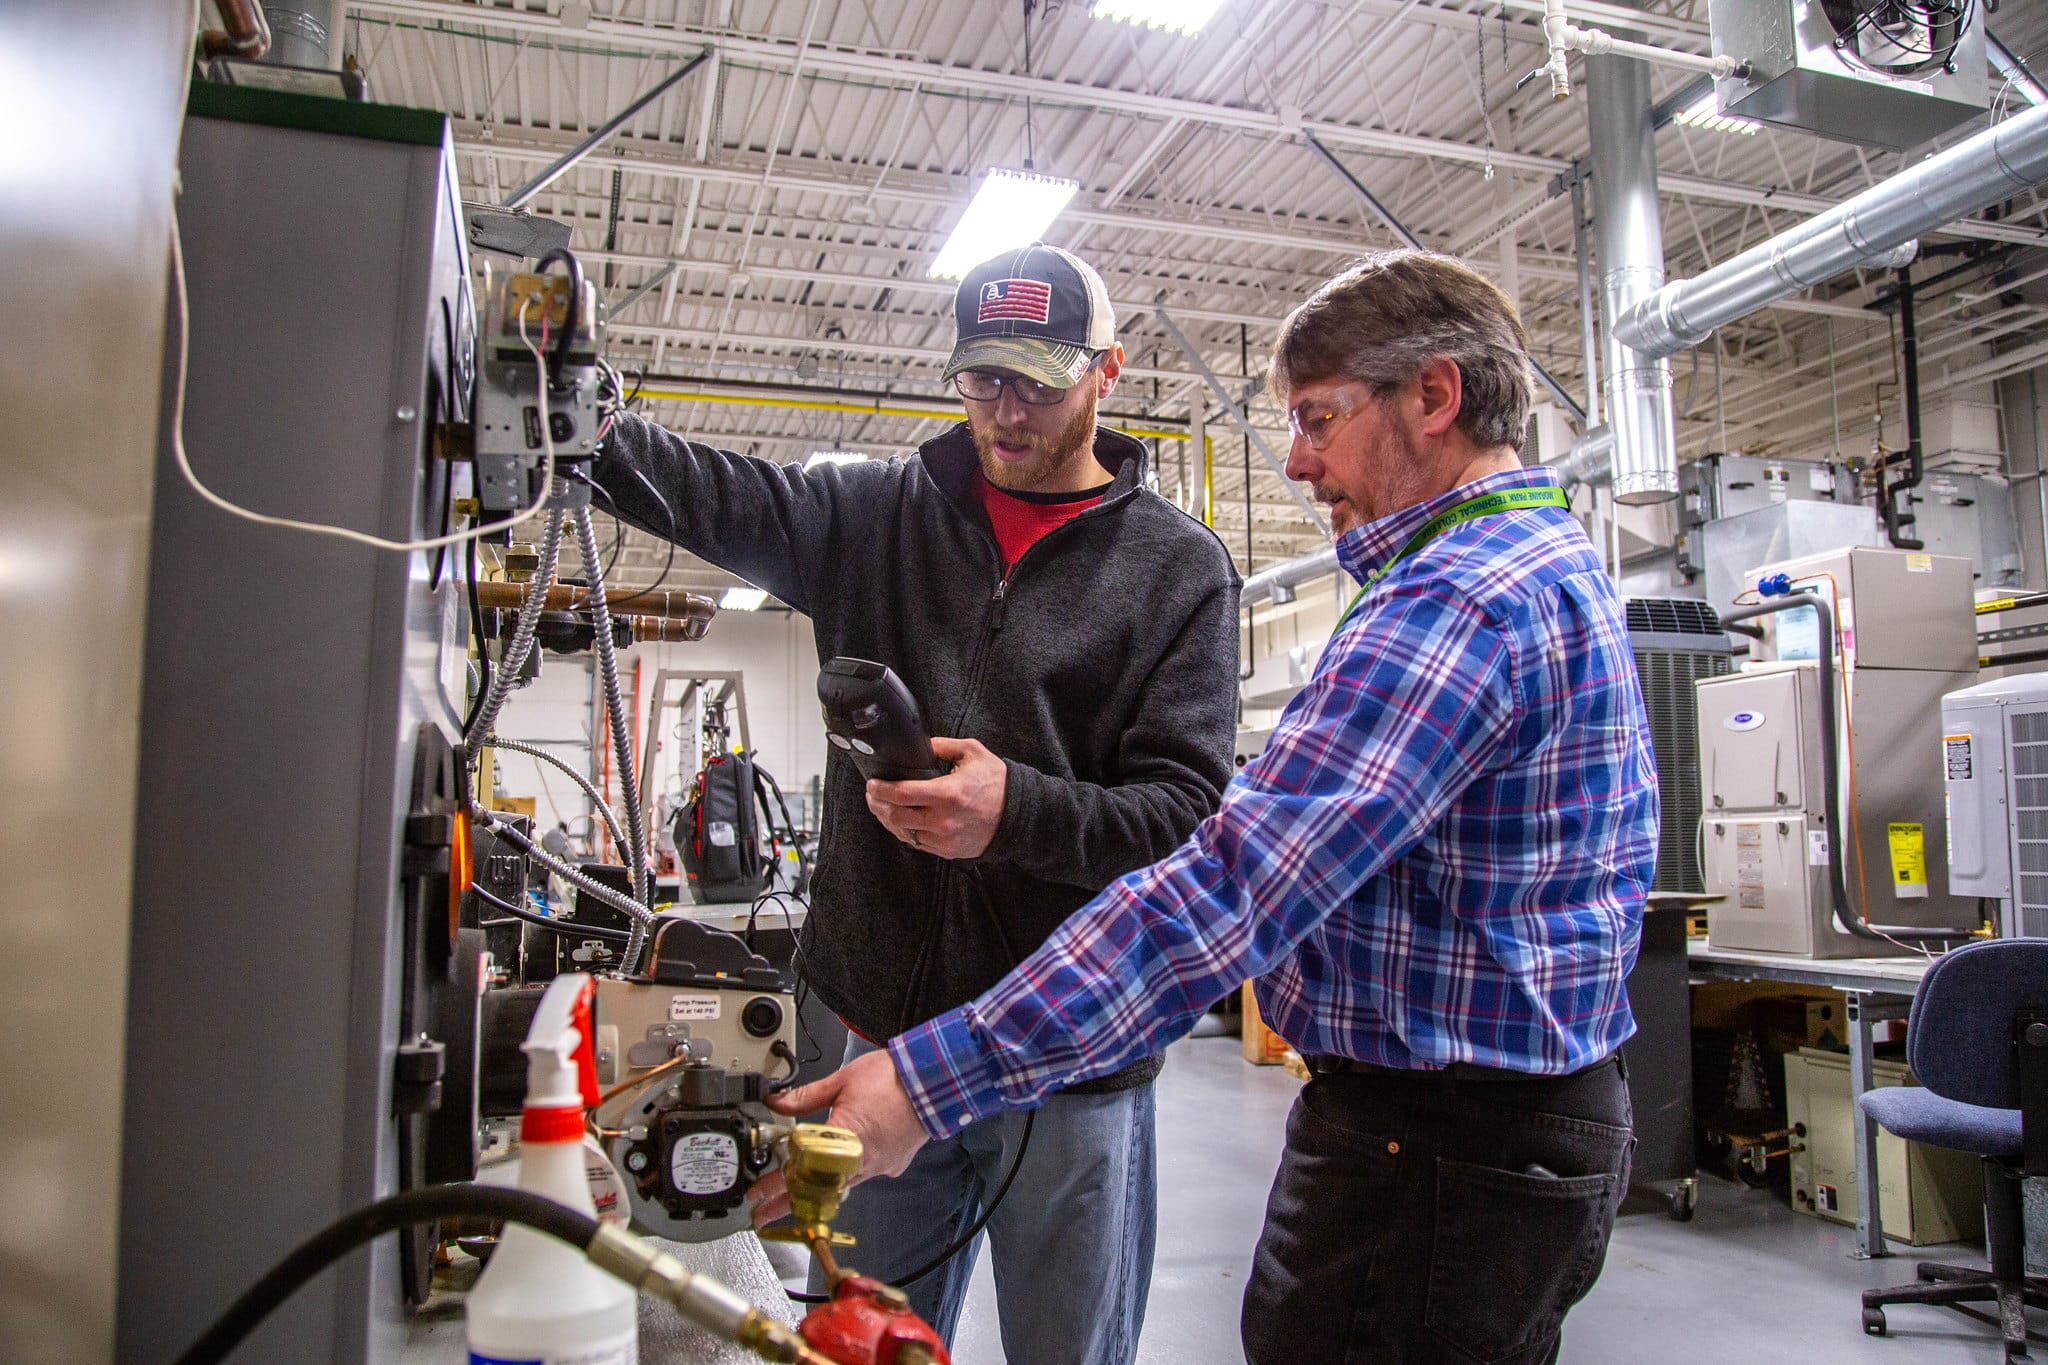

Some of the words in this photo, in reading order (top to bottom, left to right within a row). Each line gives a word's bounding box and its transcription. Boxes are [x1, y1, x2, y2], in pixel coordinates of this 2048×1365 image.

[1509, 492, 1528, 503] PARK
[1527, 491, 1554, 500] MORAINE
[1458, 495, 1507, 518] TECHNICAL
